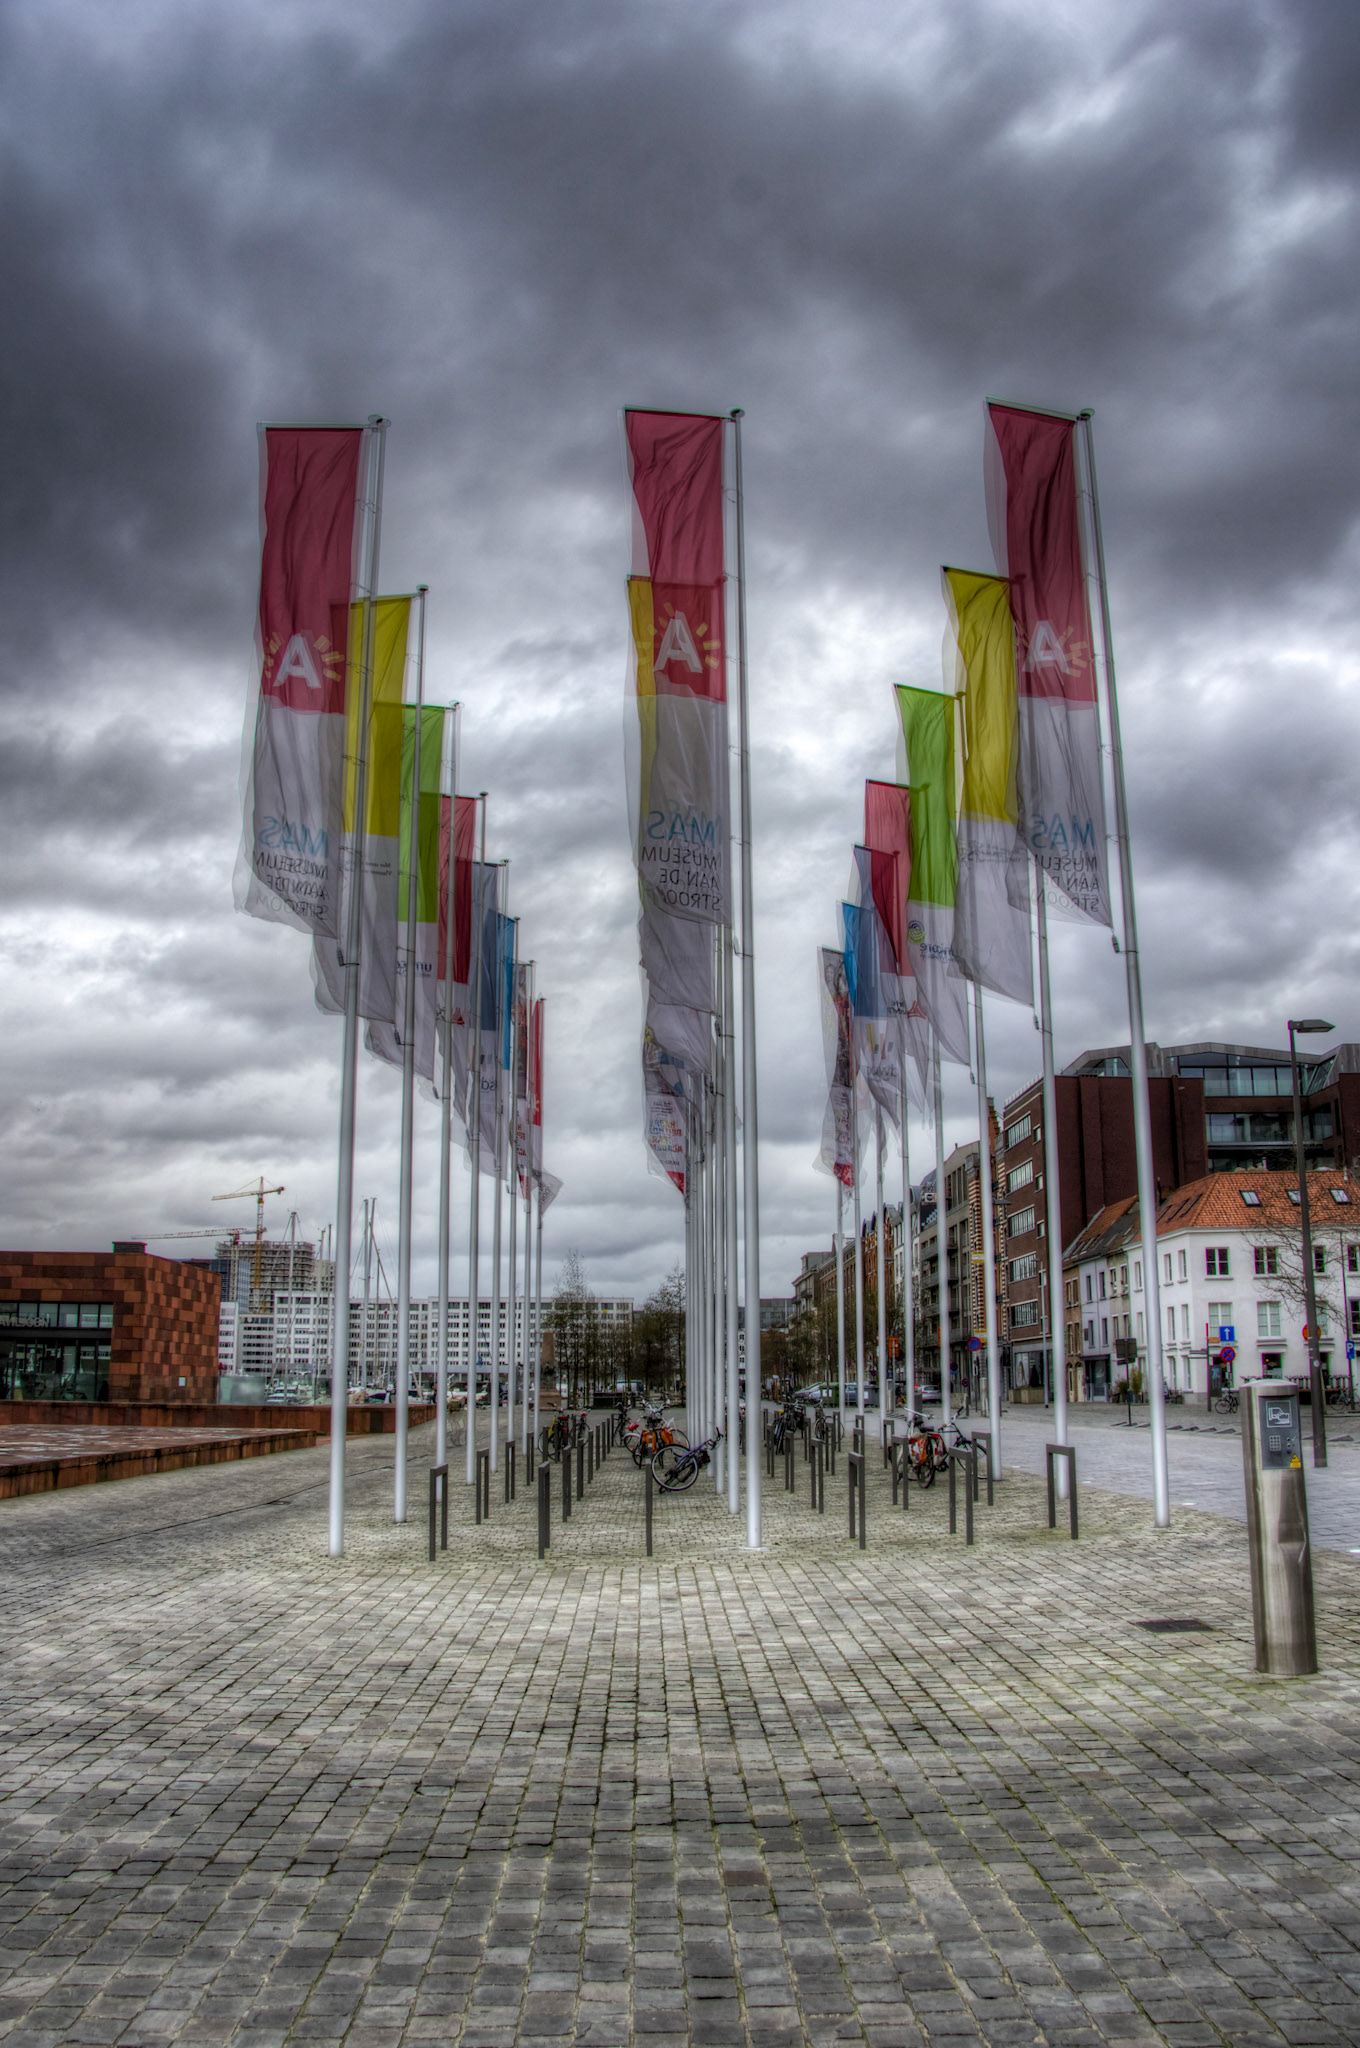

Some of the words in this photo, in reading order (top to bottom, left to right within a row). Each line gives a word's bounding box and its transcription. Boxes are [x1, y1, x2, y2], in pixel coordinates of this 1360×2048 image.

[272, 628, 321, 689] A
[654, 609, 703, 673] A
[1021, 620, 1072, 675] A
